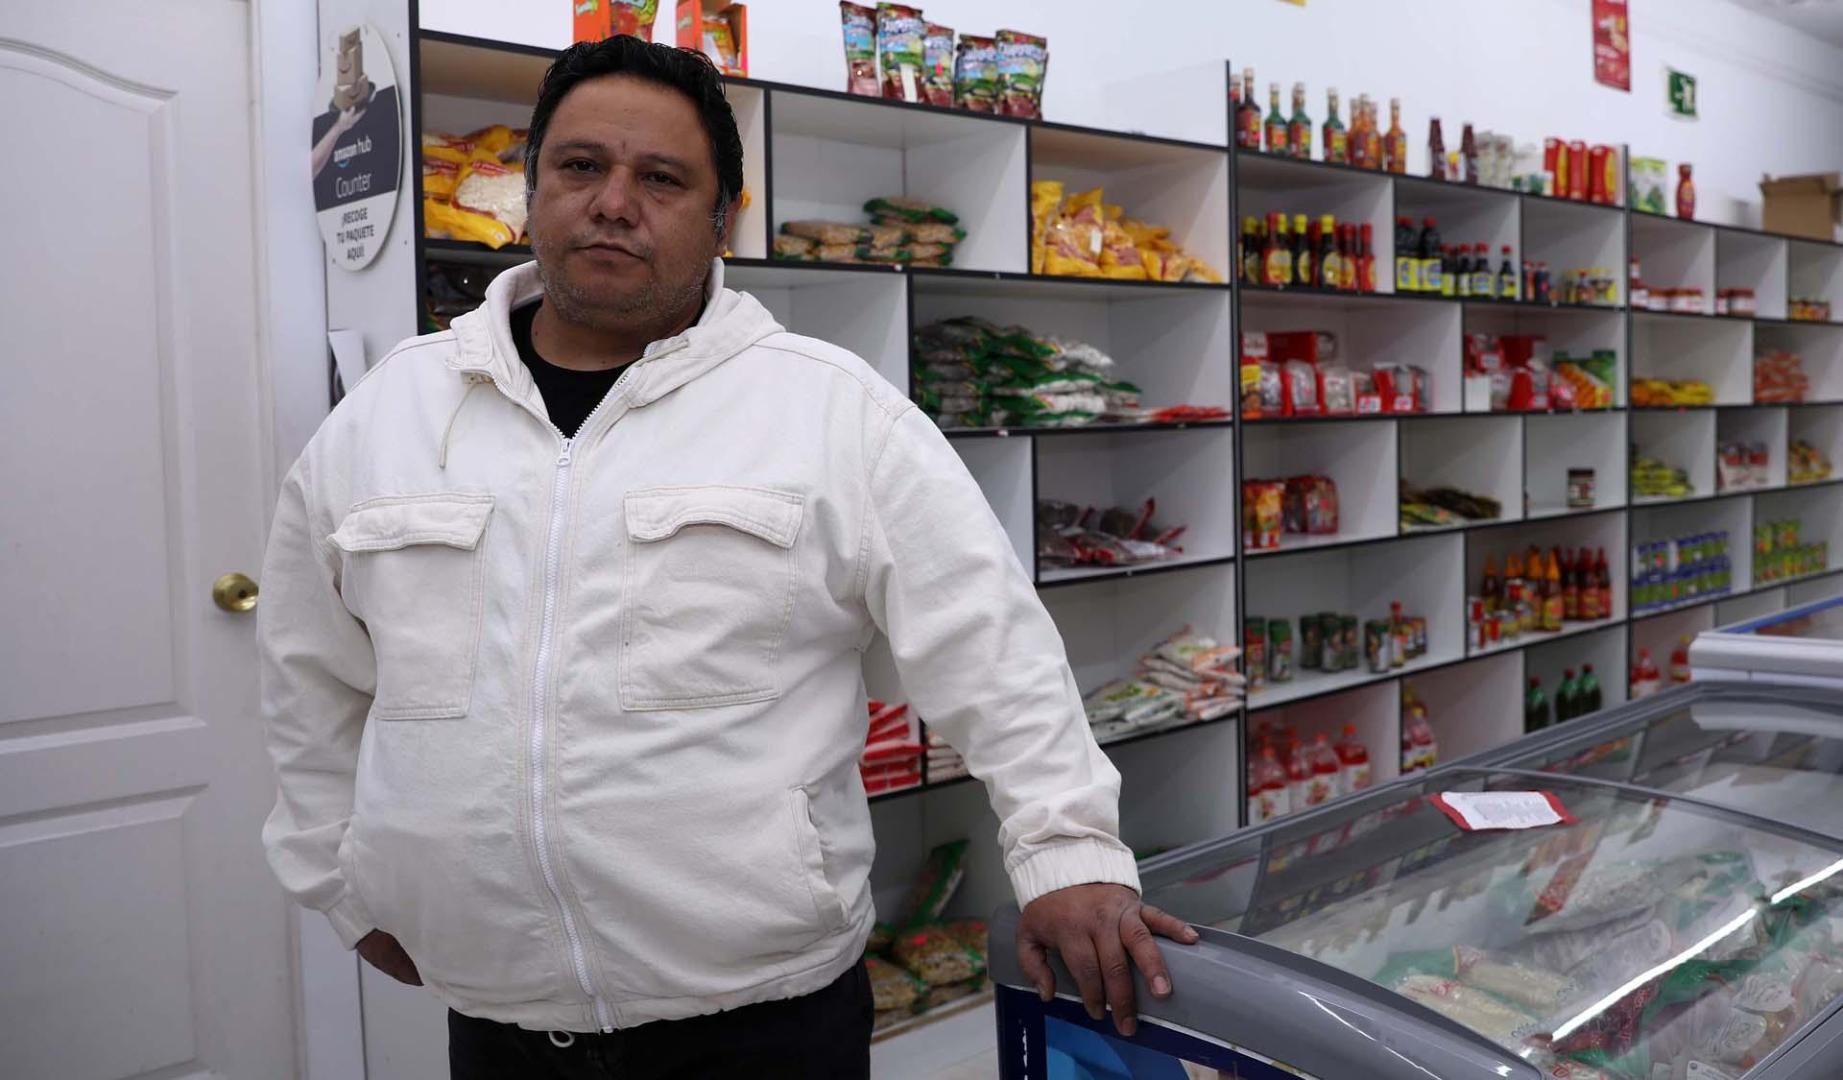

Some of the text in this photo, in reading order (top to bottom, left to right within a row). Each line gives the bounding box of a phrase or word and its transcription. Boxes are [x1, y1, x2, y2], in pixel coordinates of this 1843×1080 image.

[334, 135, 373, 162] amazon hub
[335, 173, 372, 198] Counter
[337, 224, 375, 244] TU PAQUETE
